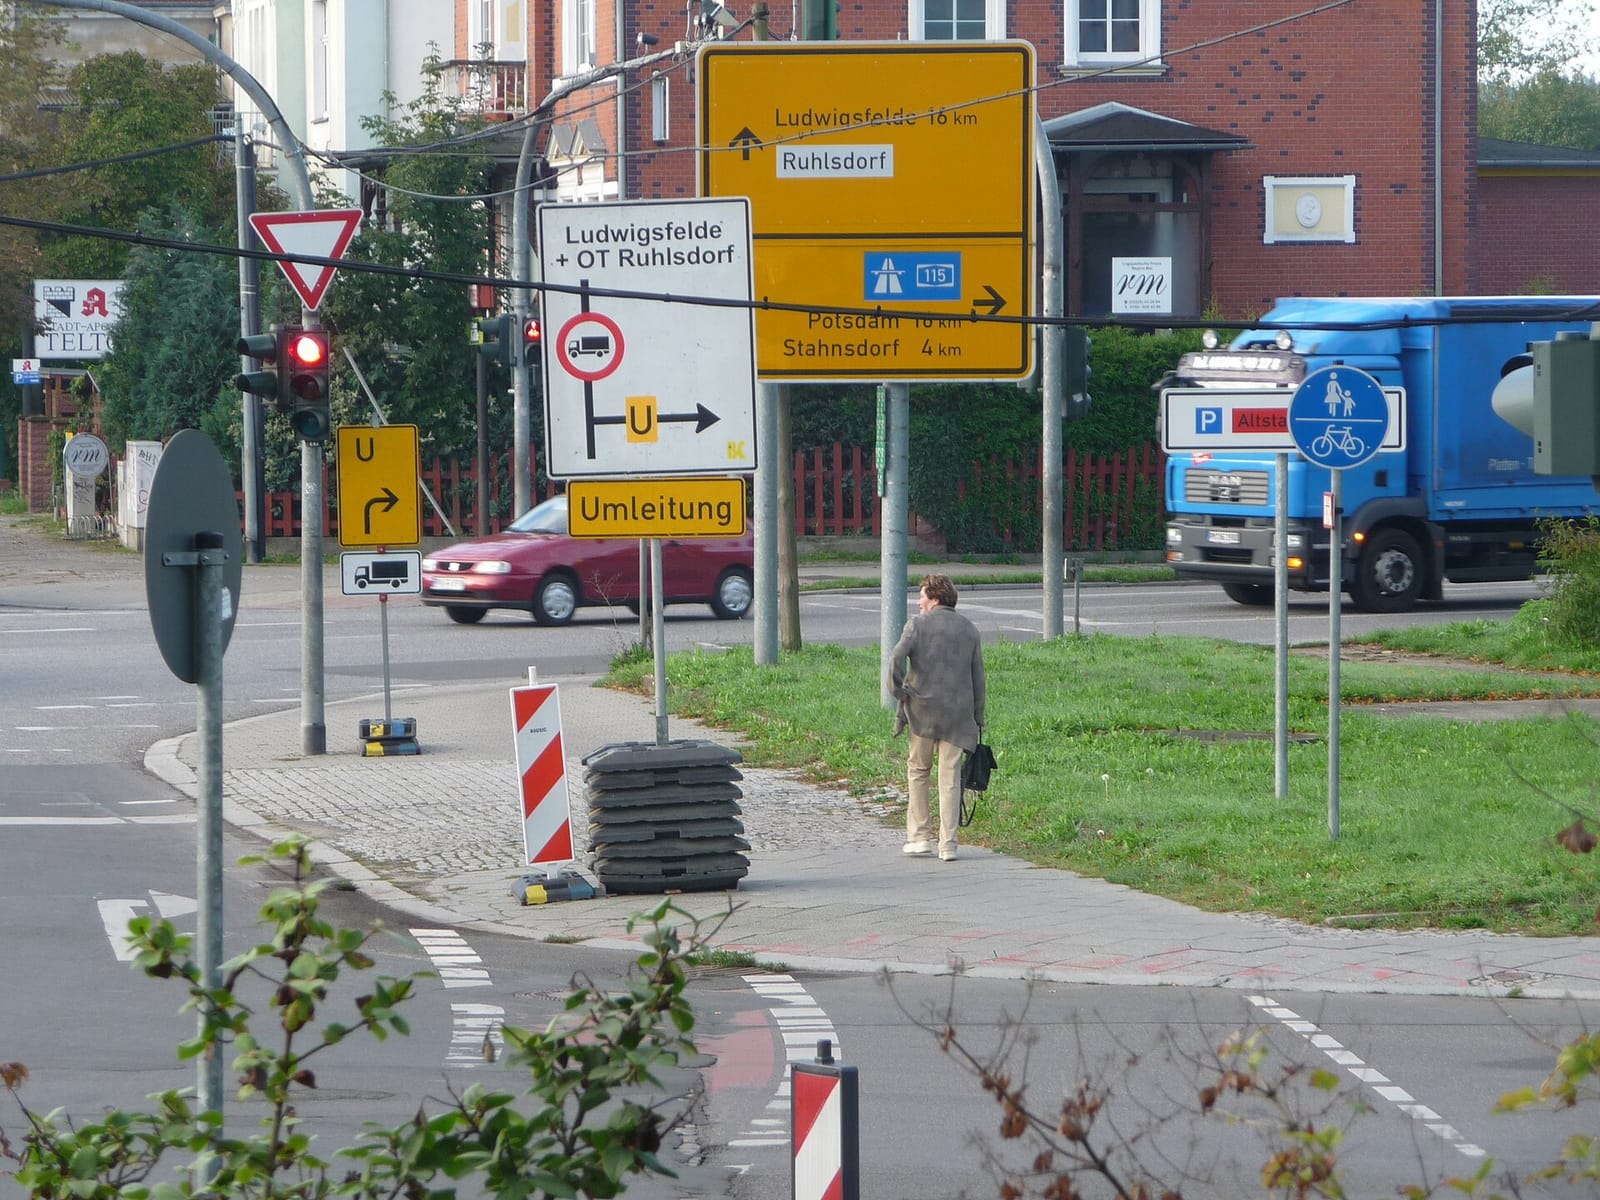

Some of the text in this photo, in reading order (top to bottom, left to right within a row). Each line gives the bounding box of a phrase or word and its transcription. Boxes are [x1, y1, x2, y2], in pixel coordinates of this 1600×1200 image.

[775, 107, 978, 127] Ludwigsfelde 16 km
[783, 152, 886, 170] Ruhlsdorf
[566, 220, 722, 246] Ludwigsfelde
[556, 245, 735, 268] + OT Ruhlsdorf
[925, 268, 946, 283] 115
[808, 312, 899, 329] Potsdam
[783, 339, 961, 357] Stahnsdorf 4 km
[630, 405, 652, 435] U
[1201, 410, 1217, 432] P
[1238, 413, 1288, 428] Altsta
[356, 437, 374, 462] U
[581, 496, 731, 526] Umleitung
